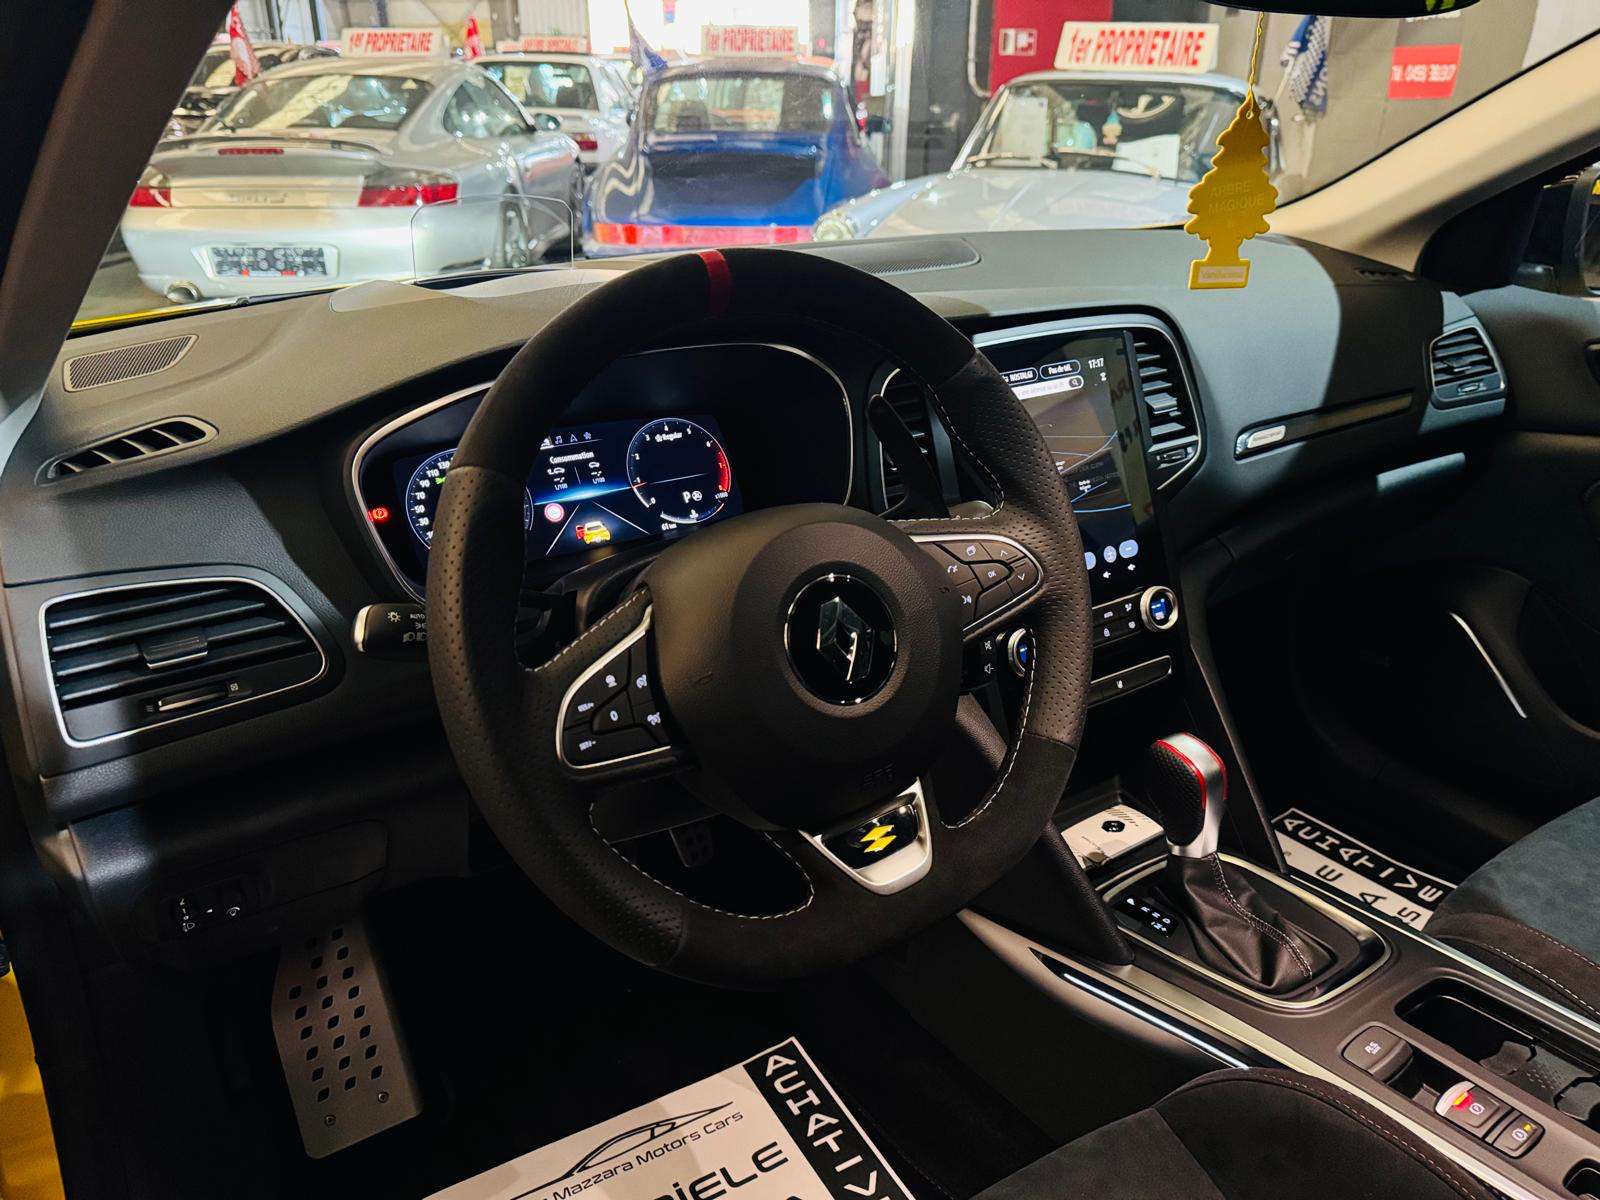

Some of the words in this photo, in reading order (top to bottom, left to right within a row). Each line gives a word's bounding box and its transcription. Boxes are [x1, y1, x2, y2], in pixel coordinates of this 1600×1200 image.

[364, 32, 432, 53] PROPRIETAIRE
[722, 28, 794, 53] PROPRIETAIRE
[1068, 30, 1092, 64] 1er
[1092, 30, 1205, 66] PROPRIETAIRE
[1208, 194, 1265, 217] MAGIQUE
[1088, 357, 1104, 369] 17:17
[549, 451, 595, 465] Consommation
[437, 461, 450, 470] 130
[426, 468, 440, 478] 110
[420, 479, 431, 488] 90
[415, 491, 426, 500] 70
[682, 490, 691, 503] P
[414, 504, 426, 514] 50
[418, 517, 429, 527] 30
[553, 1160, 634, 1200] Mazzara
[635, 1130, 701, 1164] Motors
[703, 1110, 744, 1136] Cars
